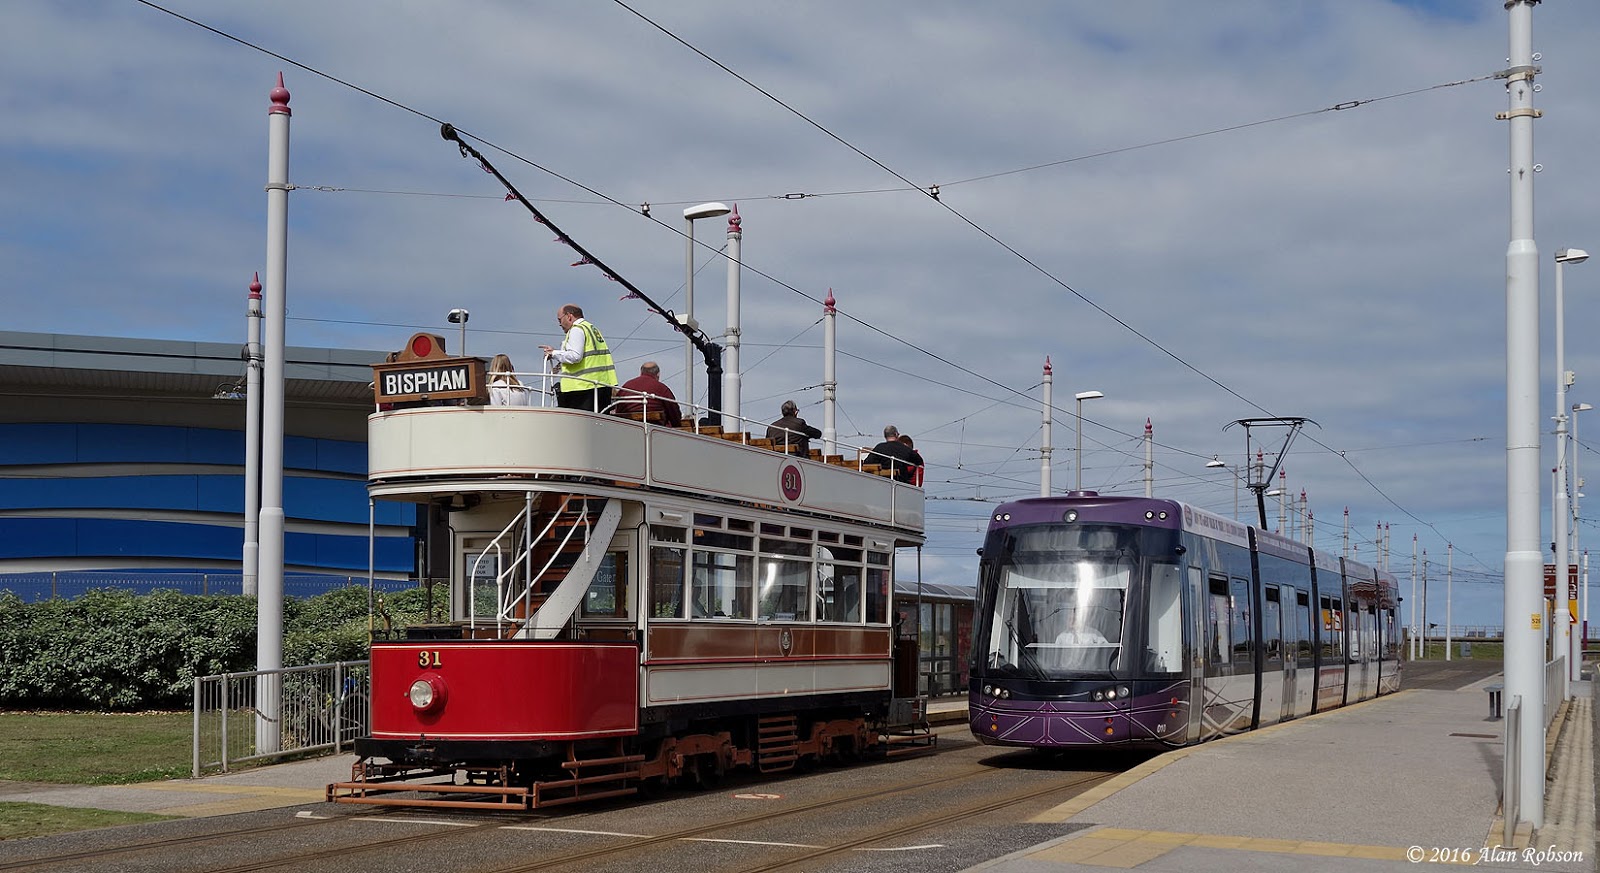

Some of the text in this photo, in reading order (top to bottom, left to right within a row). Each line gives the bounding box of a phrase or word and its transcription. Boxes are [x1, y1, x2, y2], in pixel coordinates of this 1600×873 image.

[386, 369, 466, 394] BISPHAM
[785, 472, 797, 490] 31
[419, 651, 442, 668] 31
